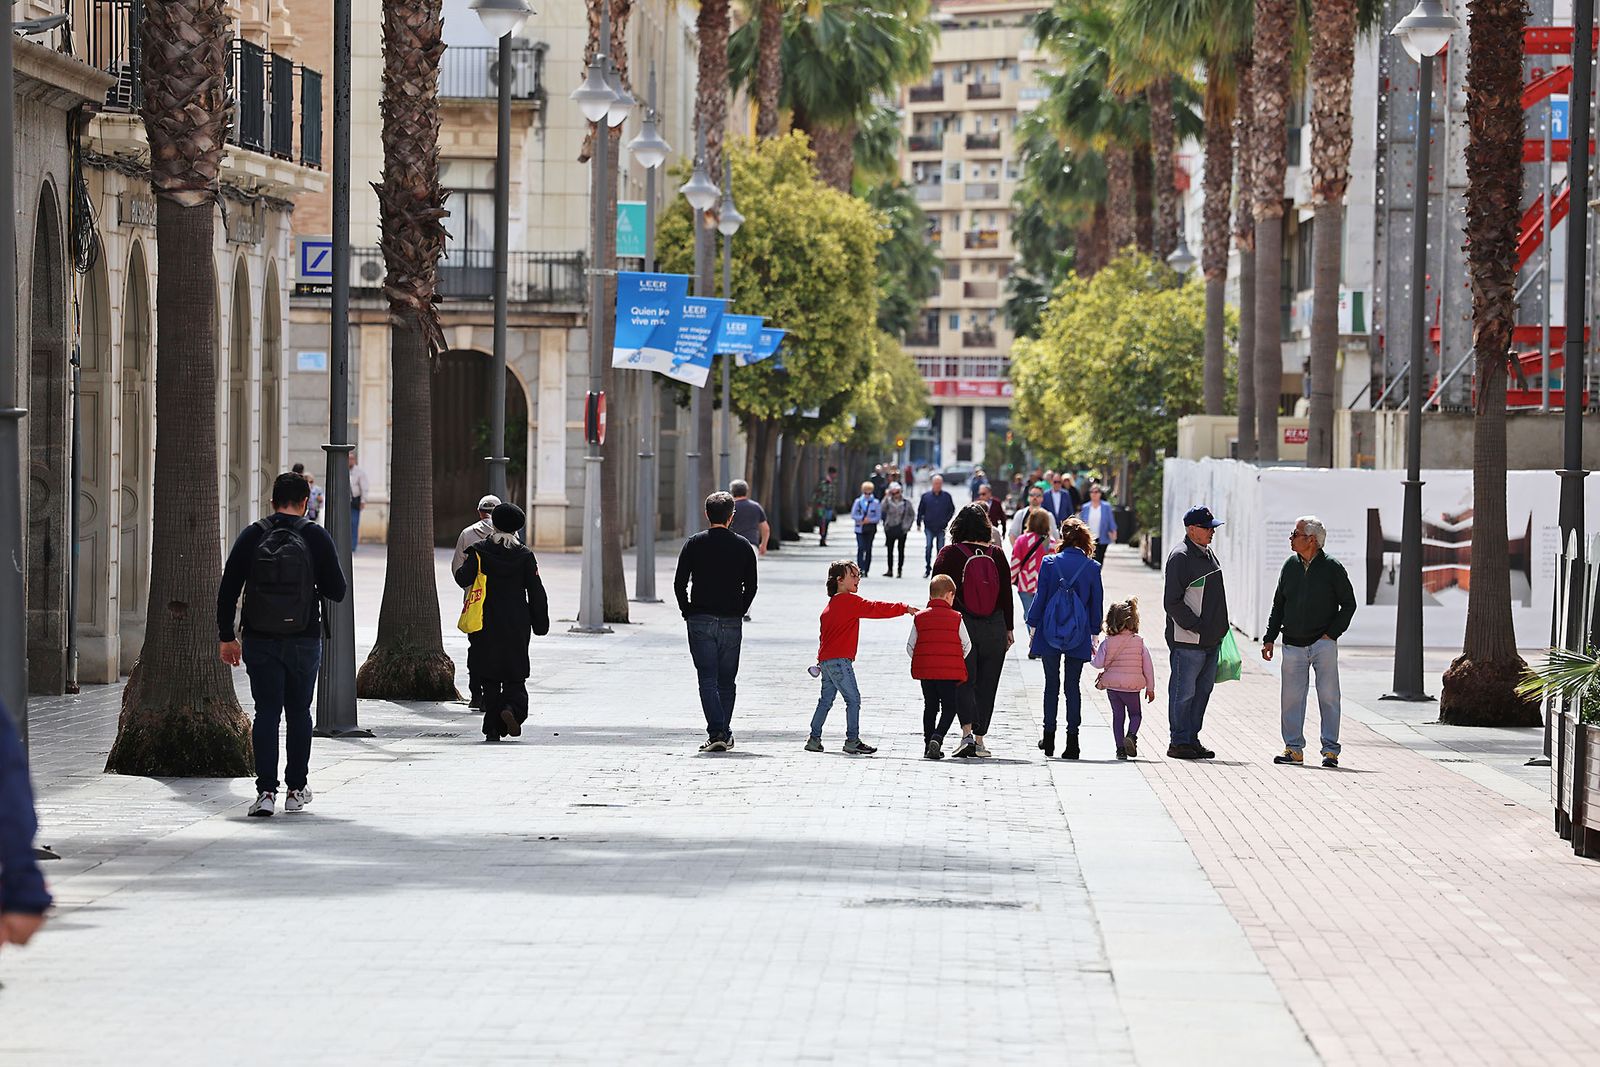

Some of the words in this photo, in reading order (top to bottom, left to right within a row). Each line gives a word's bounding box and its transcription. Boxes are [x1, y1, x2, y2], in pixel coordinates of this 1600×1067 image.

[639, 279, 667, 288] LEER
[630, 306, 657, 316] Quien
[683, 304, 707, 314] LEER
[631, 316, 649, 325] vive
